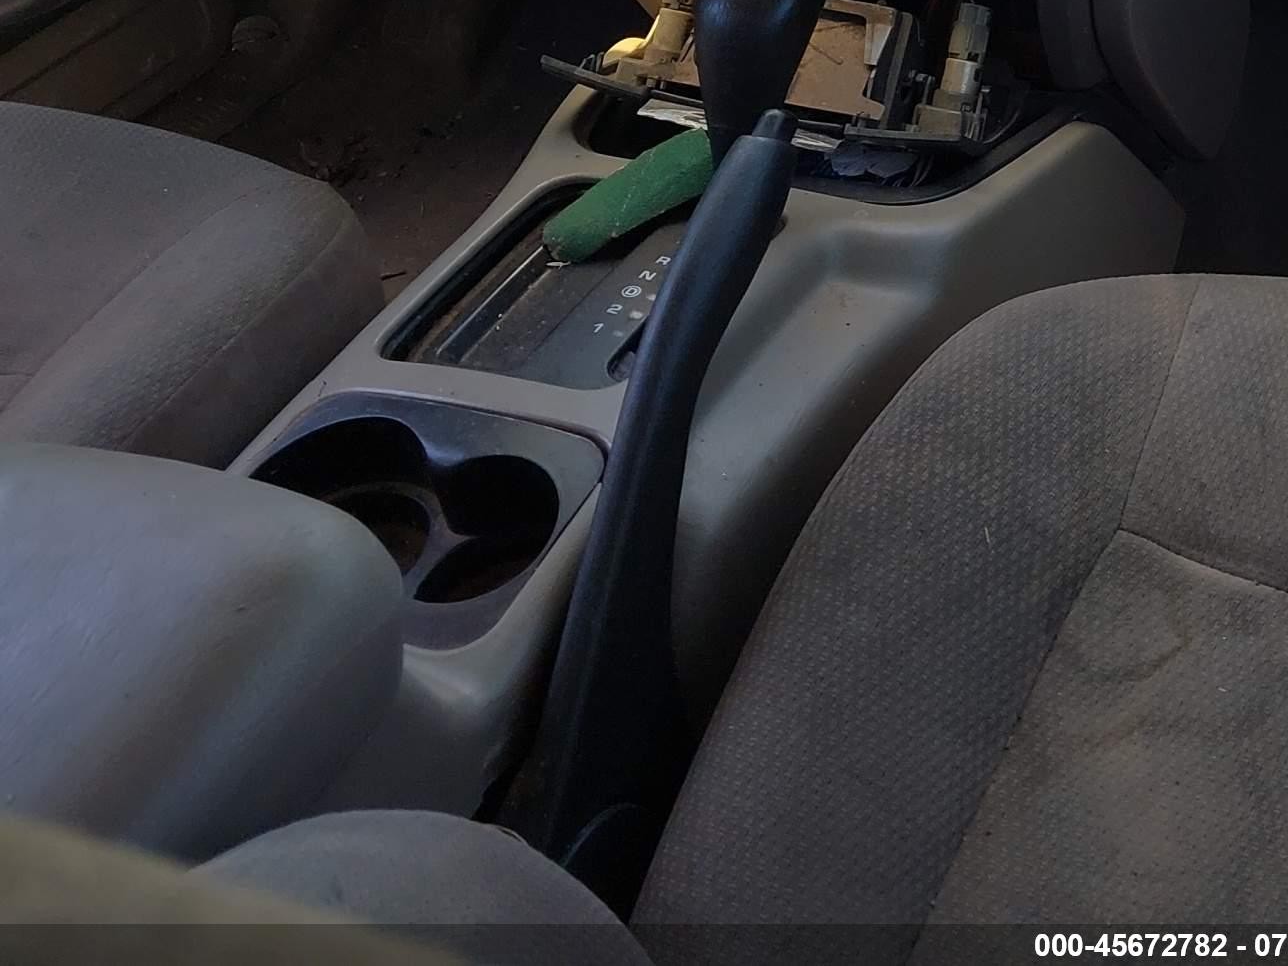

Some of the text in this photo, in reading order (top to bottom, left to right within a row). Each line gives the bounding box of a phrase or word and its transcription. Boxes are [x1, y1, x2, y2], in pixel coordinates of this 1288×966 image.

[656, 256, 672, 266] R
[639, 270, 656, 281] N
[606, 304, 623, 314] 2
[593, 322, 604, 333] 1
